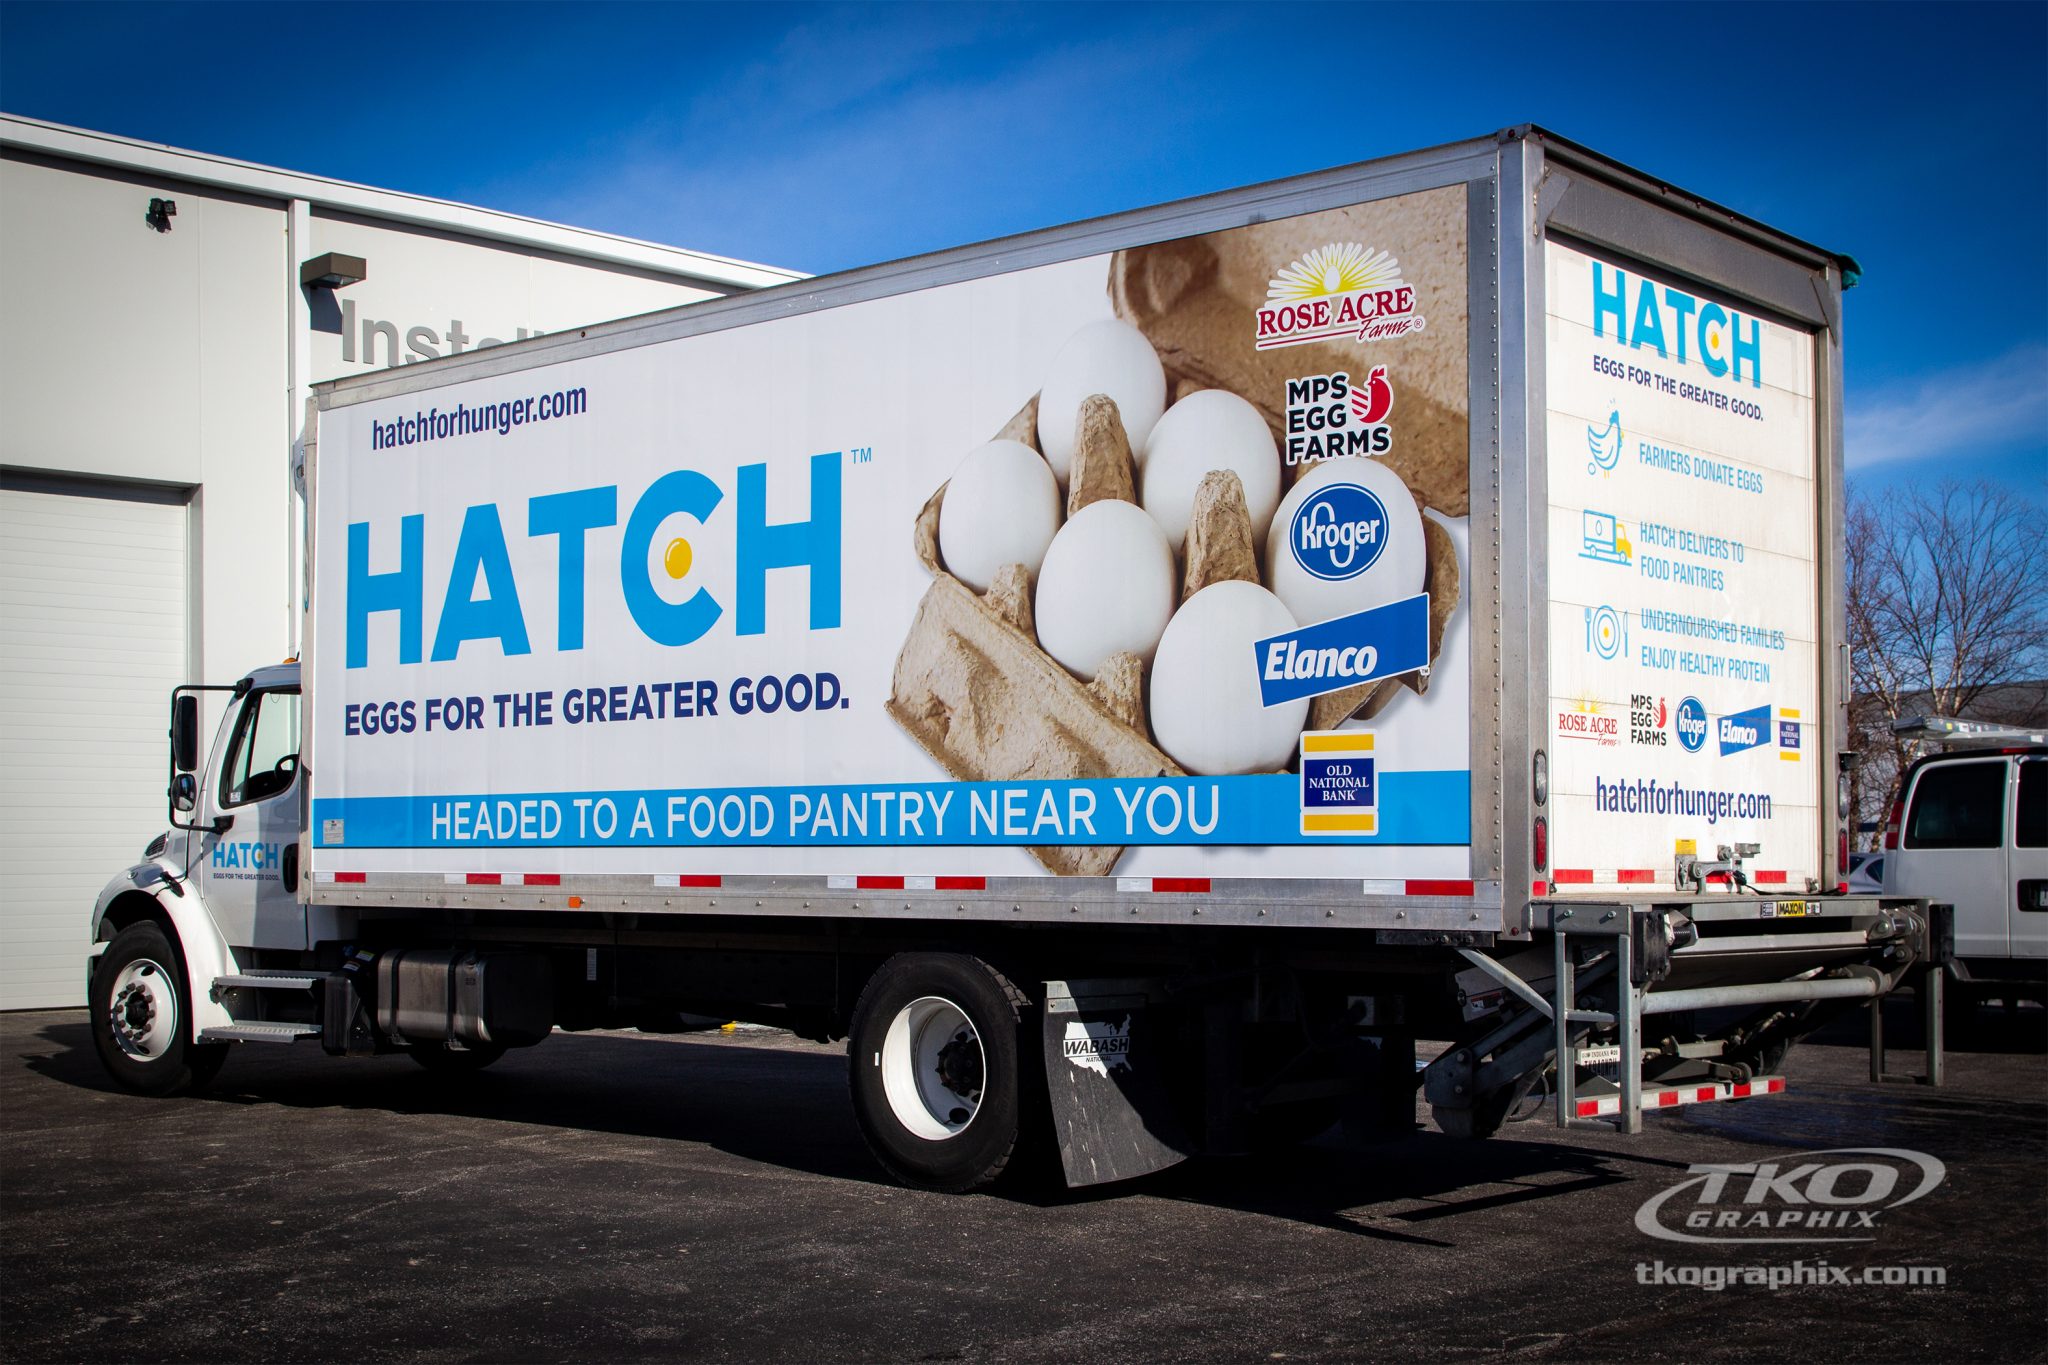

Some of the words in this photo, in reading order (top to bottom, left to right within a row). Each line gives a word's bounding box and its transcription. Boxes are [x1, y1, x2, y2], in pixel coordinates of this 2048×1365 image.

[1258, 300, 1331, 336] ROSE
[1337, 286, 1414, 323] ACRE
[1592, 261, 1761, 389] HATCH
[342, 298, 545, 368] Inst
[1288, 375, 1348, 406] MPS
[1593, 354, 1625, 380] EGGS
[1628, 366, 1651, 387] FOR
[1654, 374, 1676, 394] THE
[1679, 382, 1728, 411] GREATER
[1731, 398, 1764, 421] GOOD.
[372, 386, 587, 450] hatchforhunger.com
[1288, 404, 1347, 434] EGG
[1288, 427, 1390, 462] FARMS
[1639, 443, 1691, 475] FARMERS
[1694, 457, 1734, 486] DONATE
[1737, 468, 1763, 494] EGGS
[1301, 501, 1381, 568] Kroger
[1640, 521, 1676, 549] HATCH
[1679, 530, 1729, 560] DELIVERS
[1731, 542, 1744, 563] TO
[346, 451, 842, 670] HATCH
[1640, 556, 1669, 580] FOOD
[1673, 562, 1724, 591] PANTRIES
[1641, 608, 1738, 643] UNDERNOURISHED
[1741, 624, 1785, 651] FAMILIES
[1264, 639, 1378, 681] Elanco
[1641, 646, 1676, 670] ENJOY
[1679, 652, 1725, 678] HEALTHY
[1728, 658, 1770, 683] PROTEIN
[345, 701, 417, 736] EGGS
[426, 697, 484, 731] FOR
[493, 690, 554, 728] THE
[563, 680, 719, 725] GREATER
[729, 672, 850, 715] GOOD.
[1630, 694, 1652, 711] MPS
[1630, 711, 1652, 728] EGG
[1558, 713, 1587, 732] ROSE
[1590, 716, 1618, 735] ACRE
[1630, 729, 1667, 747] FARMS
[1679, 704, 1706, 746] Kroger
[1720, 719, 1757, 746] Elanco
[1309, 777, 1369, 789] NATIONAL
[1326, 765, 1352, 776] OLD
[432, 800, 562, 840] HEADED
[573, 798, 619, 839] TO
[629, 797, 655, 838] A
[667, 794, 774, 838] FOOD
[789, 789, 954, 837] PANTRY
[970, 788, 1097, 836] NEAR
[1113, 785, 1220, 836] YOU
[1322, 789, 1356, 801] BANK
[1595, 775, 1772, 825] hatchforhunger.com
[213, 842, 278, 870] HATCH
[1779, 902, 1804, 915] MAXON
[1064, 1038, 1129, 1055] WABASH
